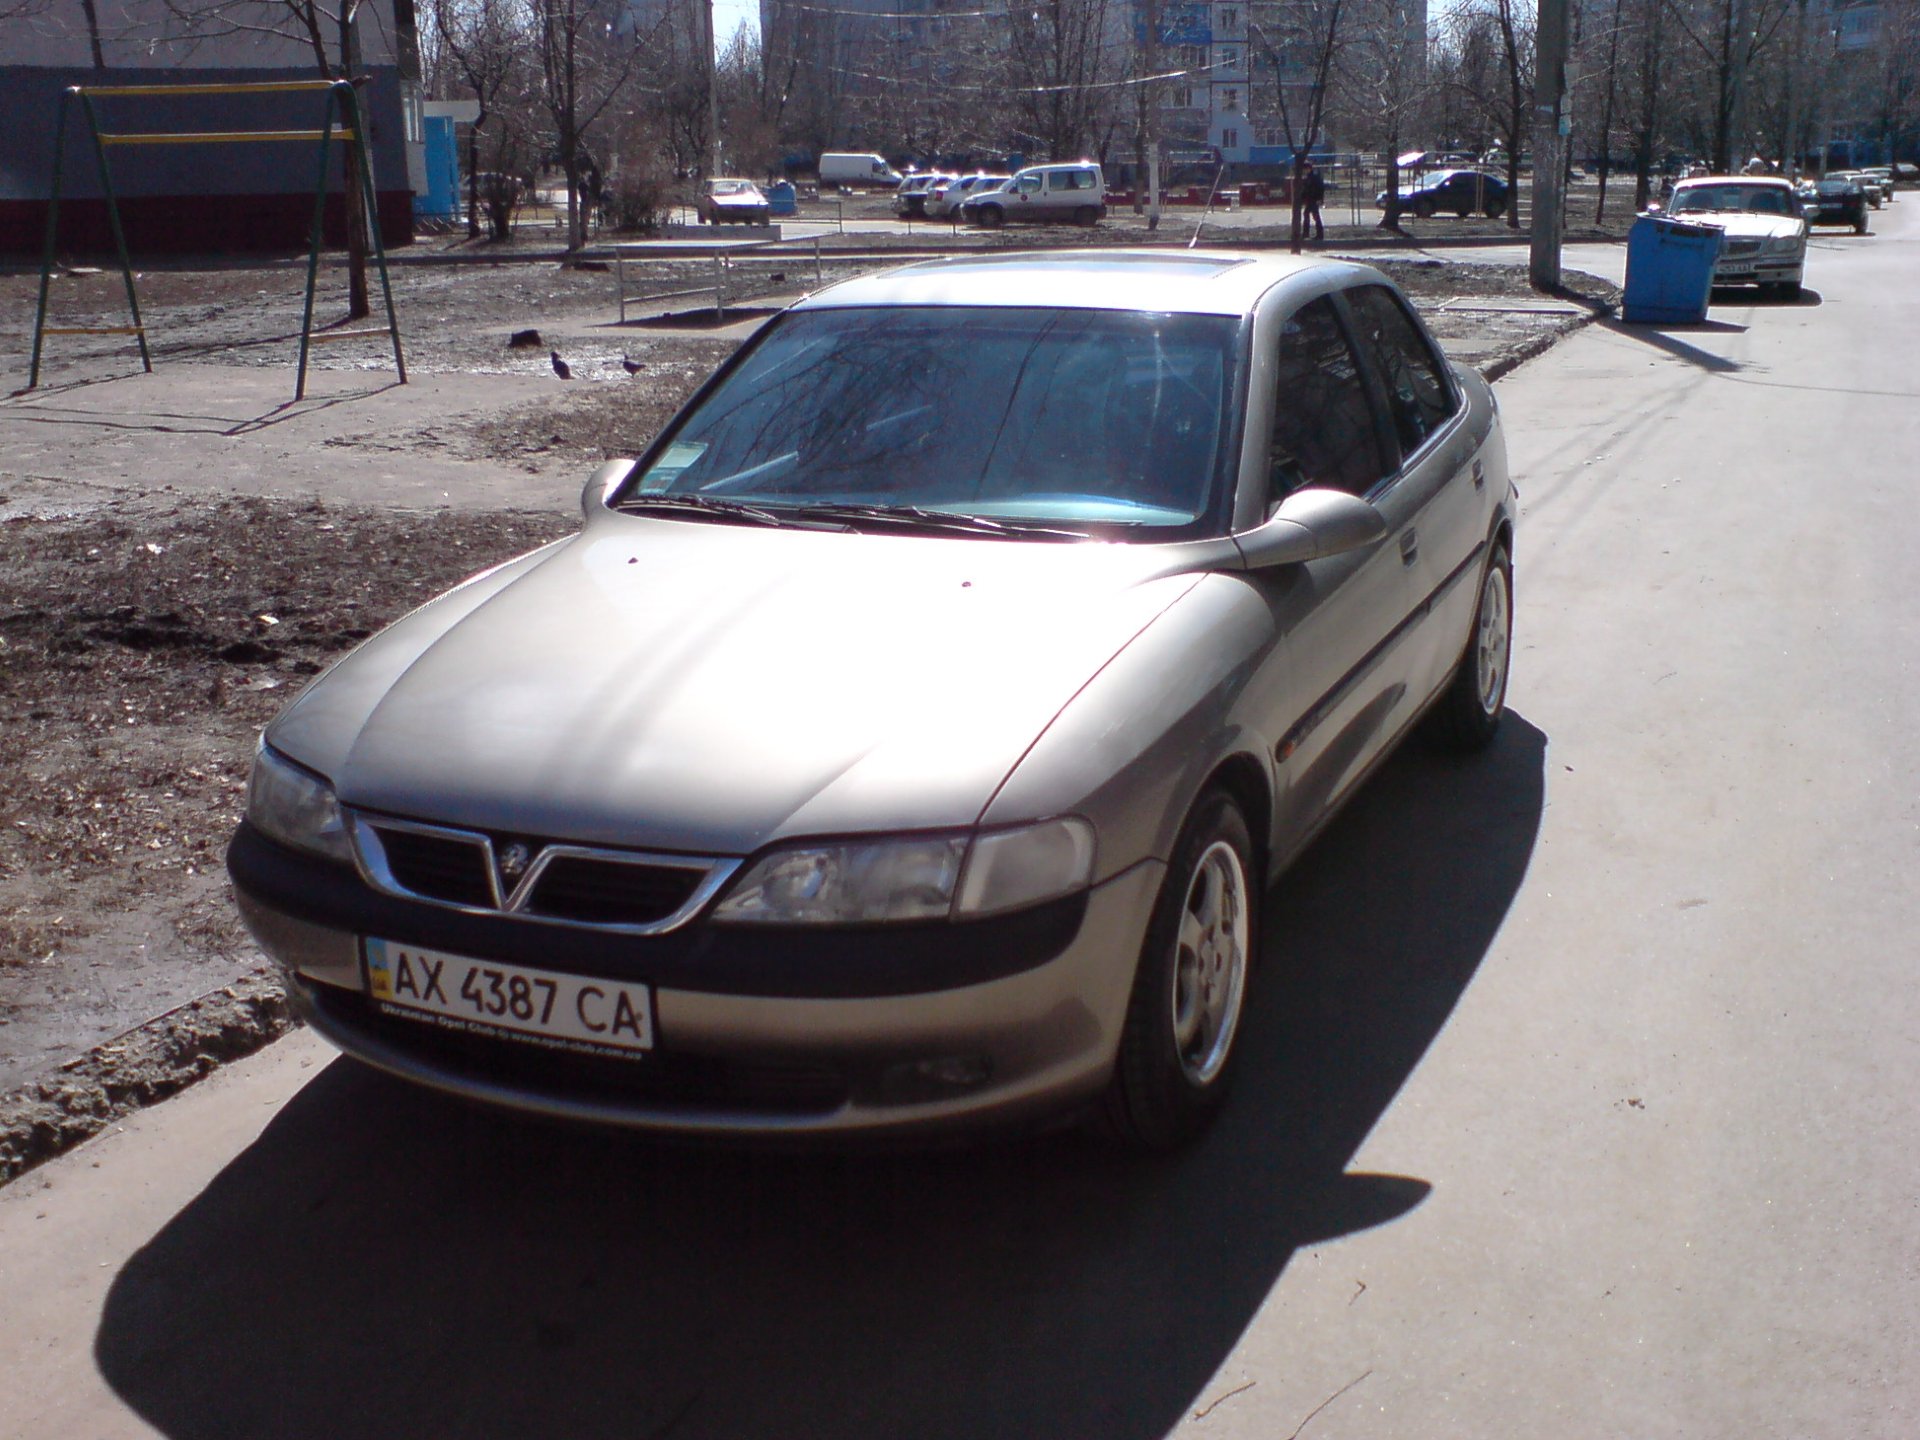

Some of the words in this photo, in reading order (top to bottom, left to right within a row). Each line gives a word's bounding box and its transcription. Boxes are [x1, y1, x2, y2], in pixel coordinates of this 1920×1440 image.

[395, 951, 448, 1006] AX
[460, 966, 558, 1026] 4387
[576, 986, 642, 1039] CA
